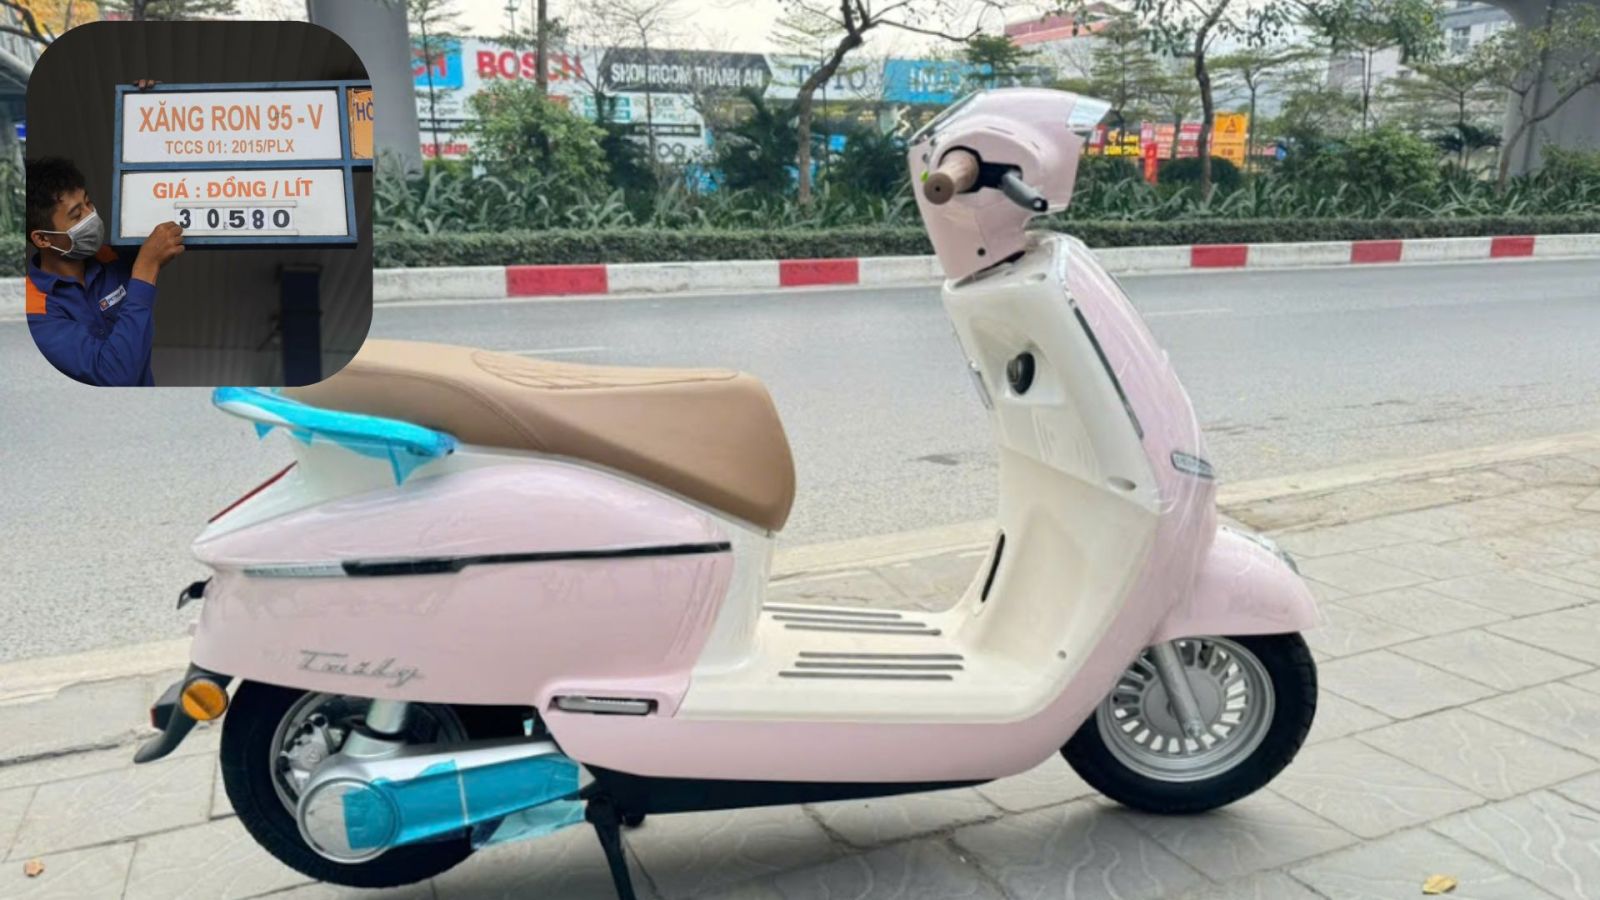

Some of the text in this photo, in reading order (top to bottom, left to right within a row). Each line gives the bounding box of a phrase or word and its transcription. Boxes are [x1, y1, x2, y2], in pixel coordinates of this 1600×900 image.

[138, 101, 204, 133] XĂNG
[211, 105, 261, 131] RON
[267, 104, 293, 130] 95
[166, 139, 295, 155] TCCS 01: 2015/PLX
[153, 179, 189, 199] GIÁ
[283, 177, 313, 197] LÍT
